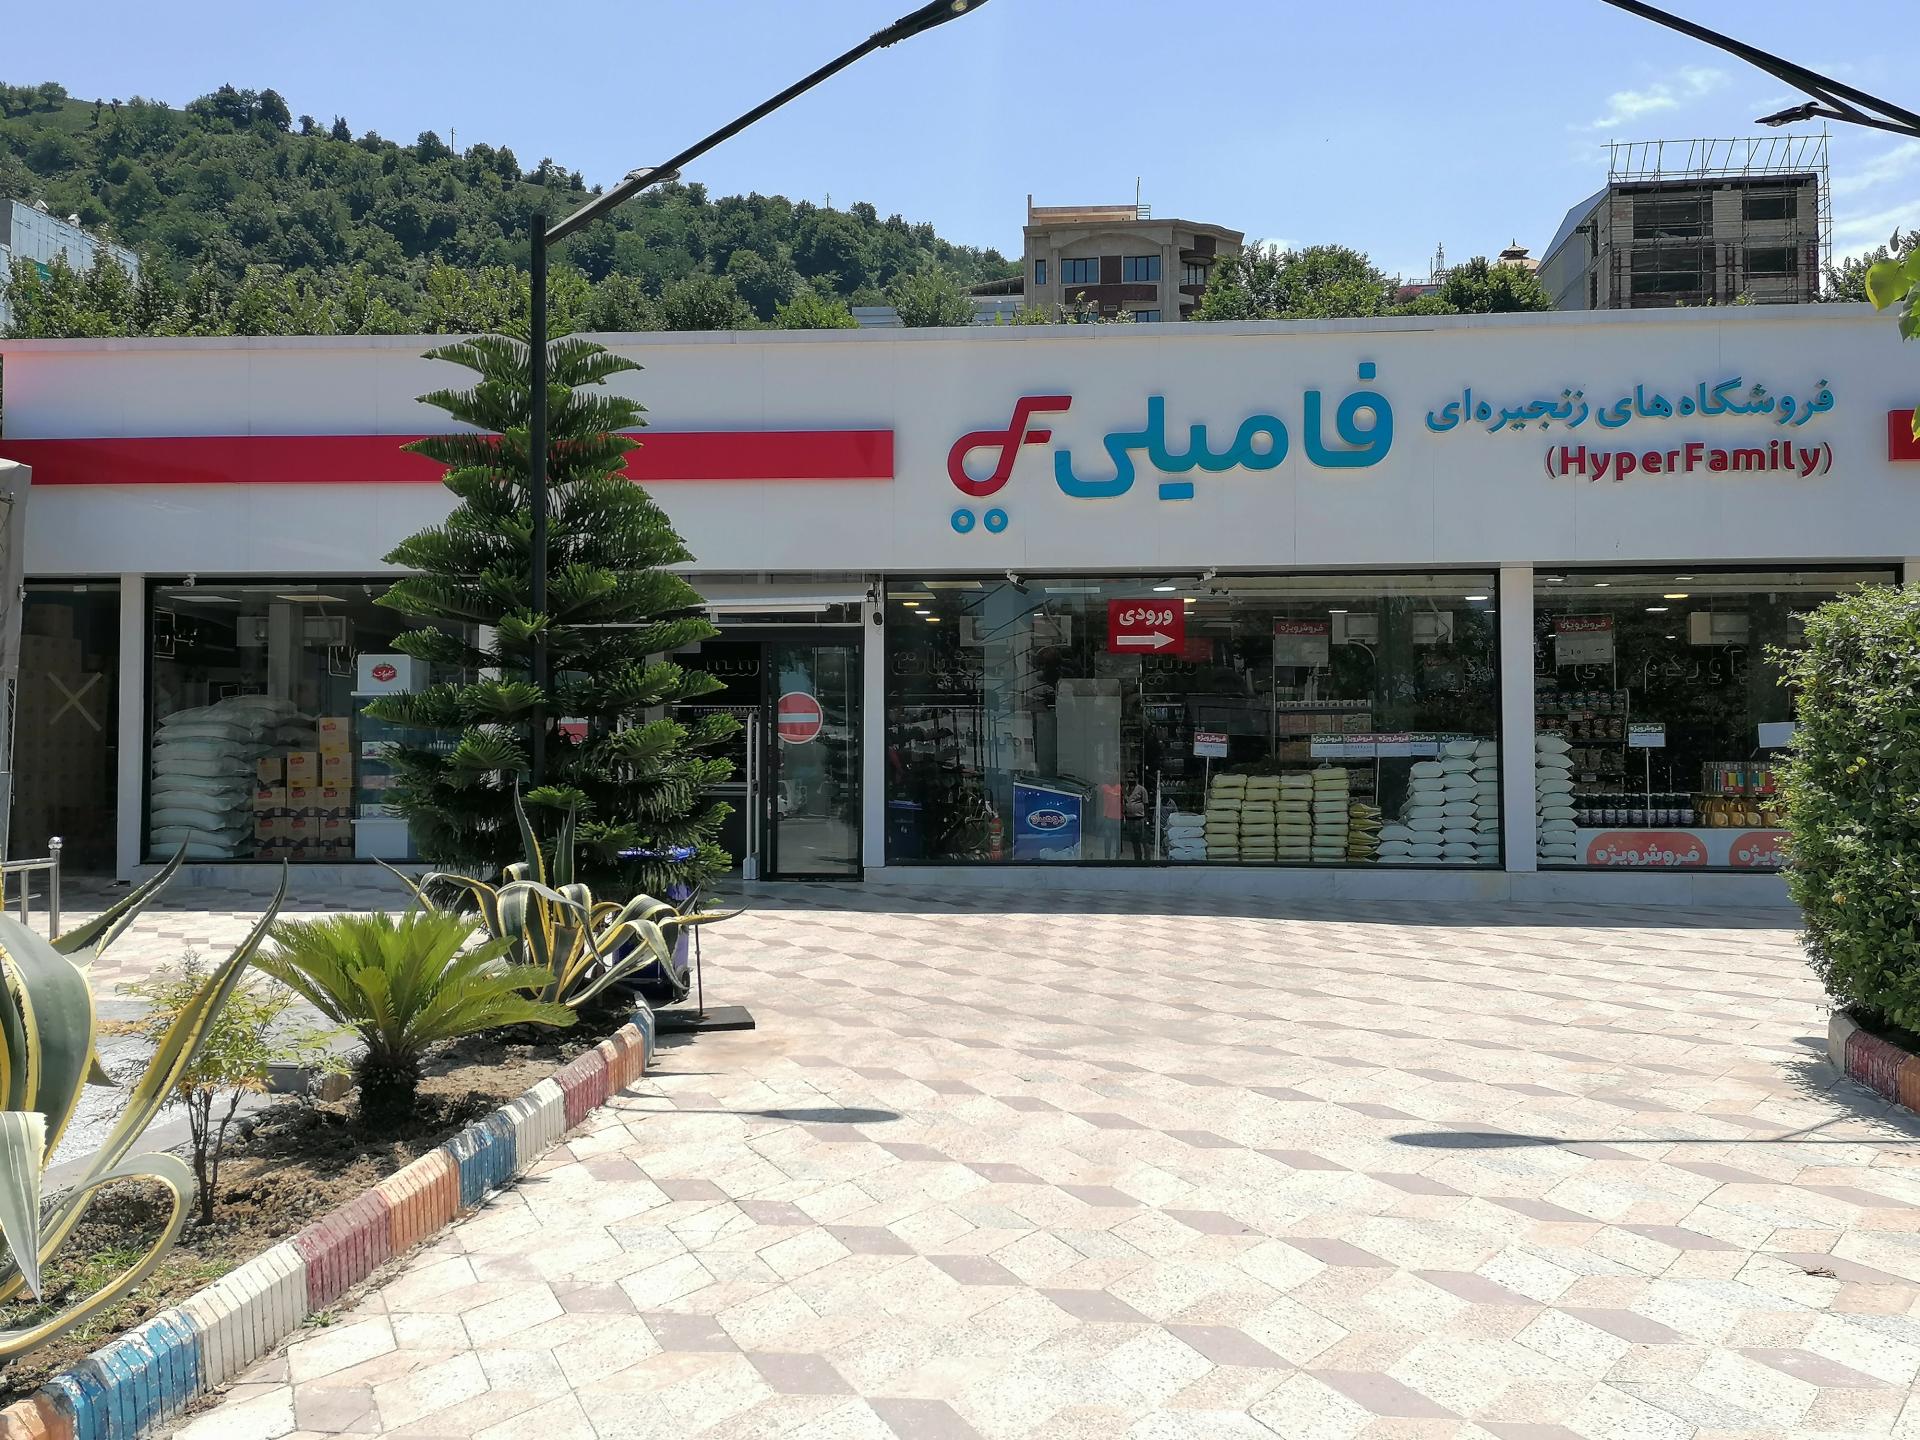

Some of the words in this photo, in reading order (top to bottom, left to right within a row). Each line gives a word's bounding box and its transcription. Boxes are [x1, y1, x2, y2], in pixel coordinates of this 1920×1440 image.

[1054, 361, 1395, 500] فامیلی
[1545, 439, 1834, 482] (HyperFamily)
[1118, 608, 1174, 626] ورودی
